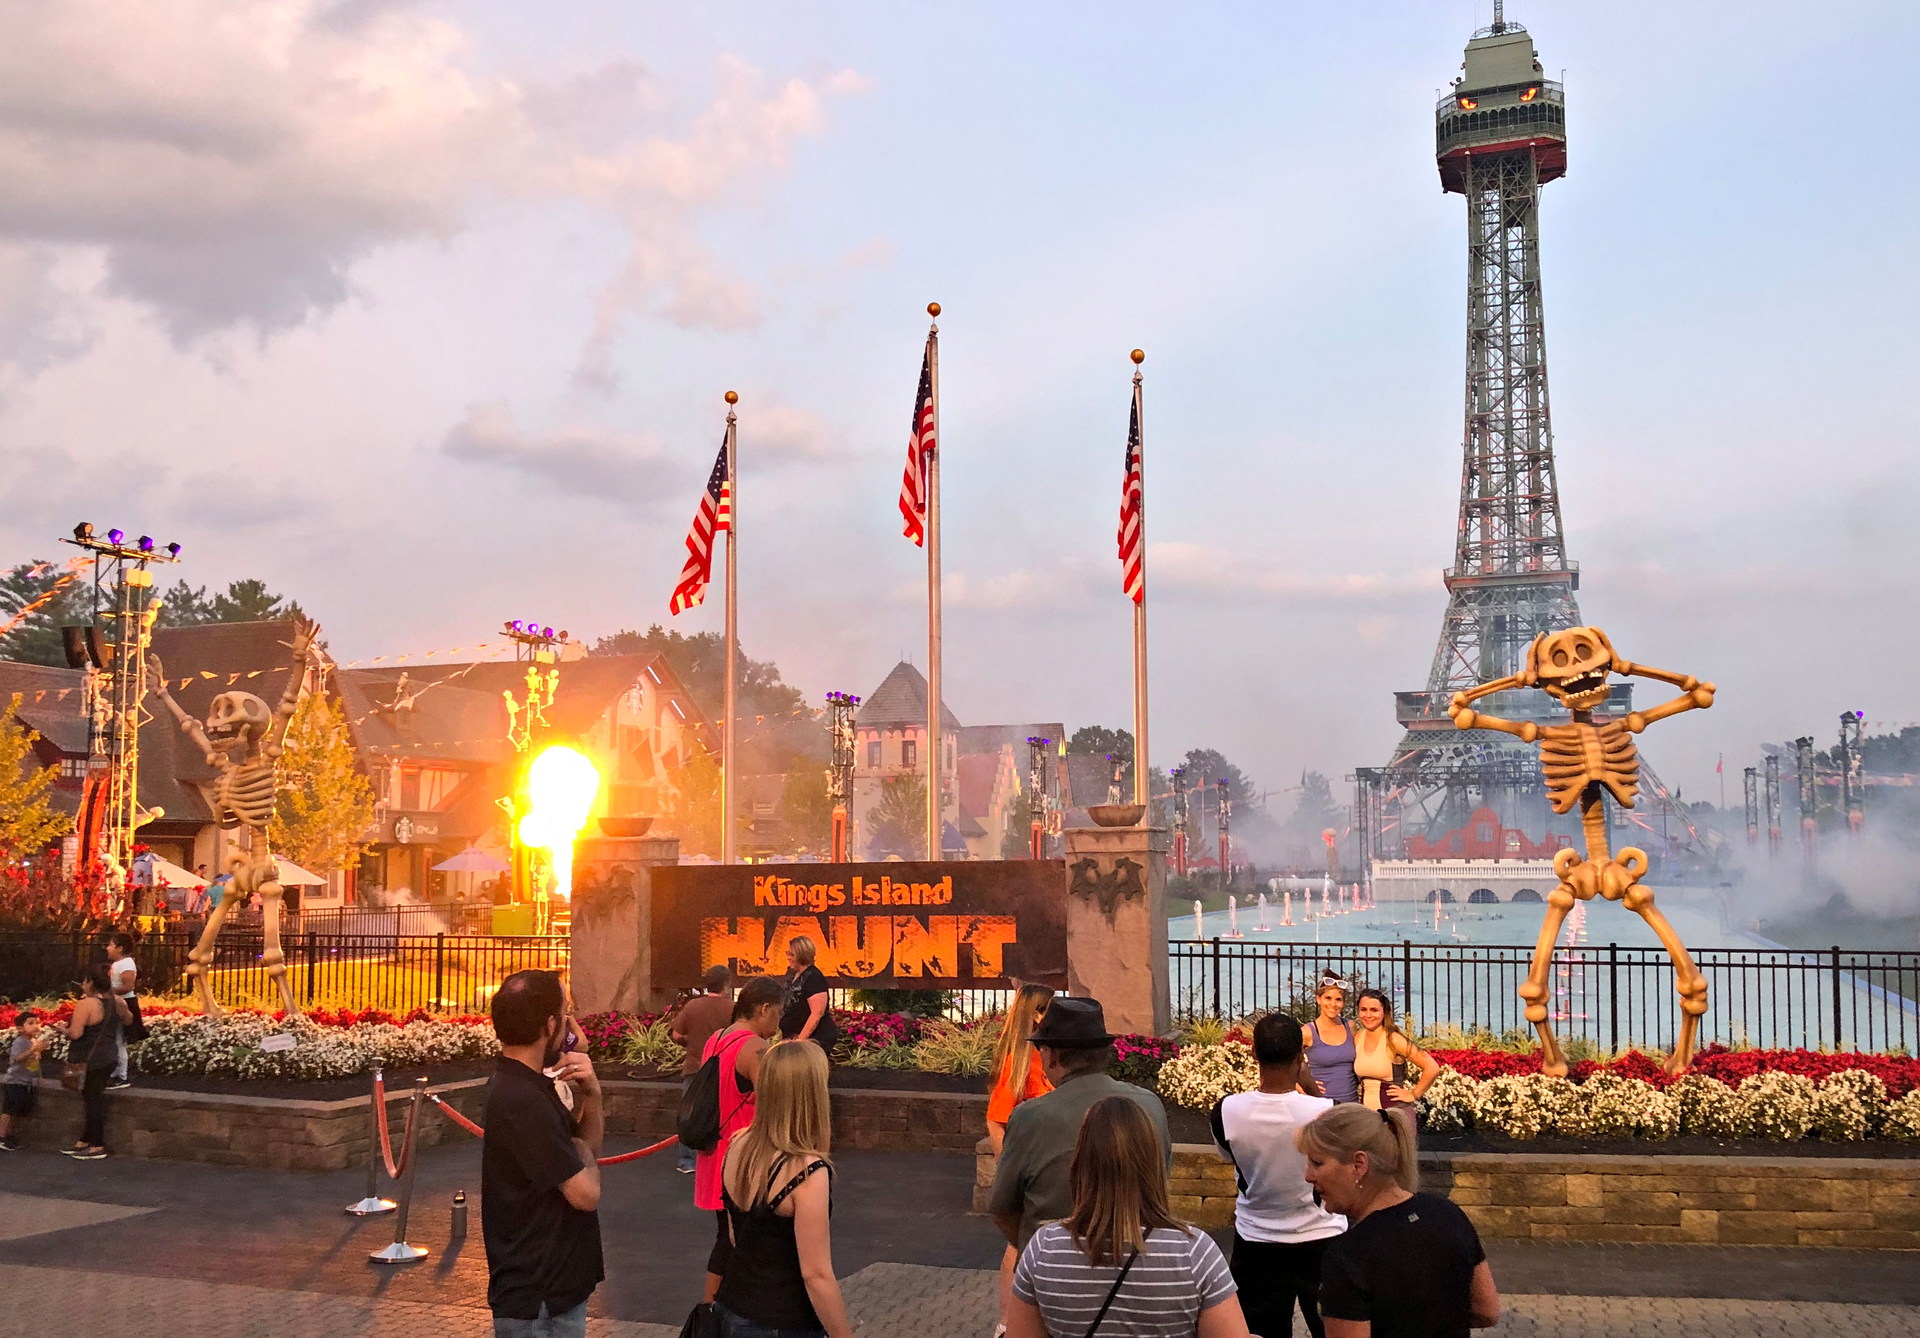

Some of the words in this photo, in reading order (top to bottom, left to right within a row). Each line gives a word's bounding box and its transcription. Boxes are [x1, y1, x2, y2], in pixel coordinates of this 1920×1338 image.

[754, 875, 846, 912] Kings
[852, 876, 953, 905] Island
[701, 915, 1016, 977] HAUNT
